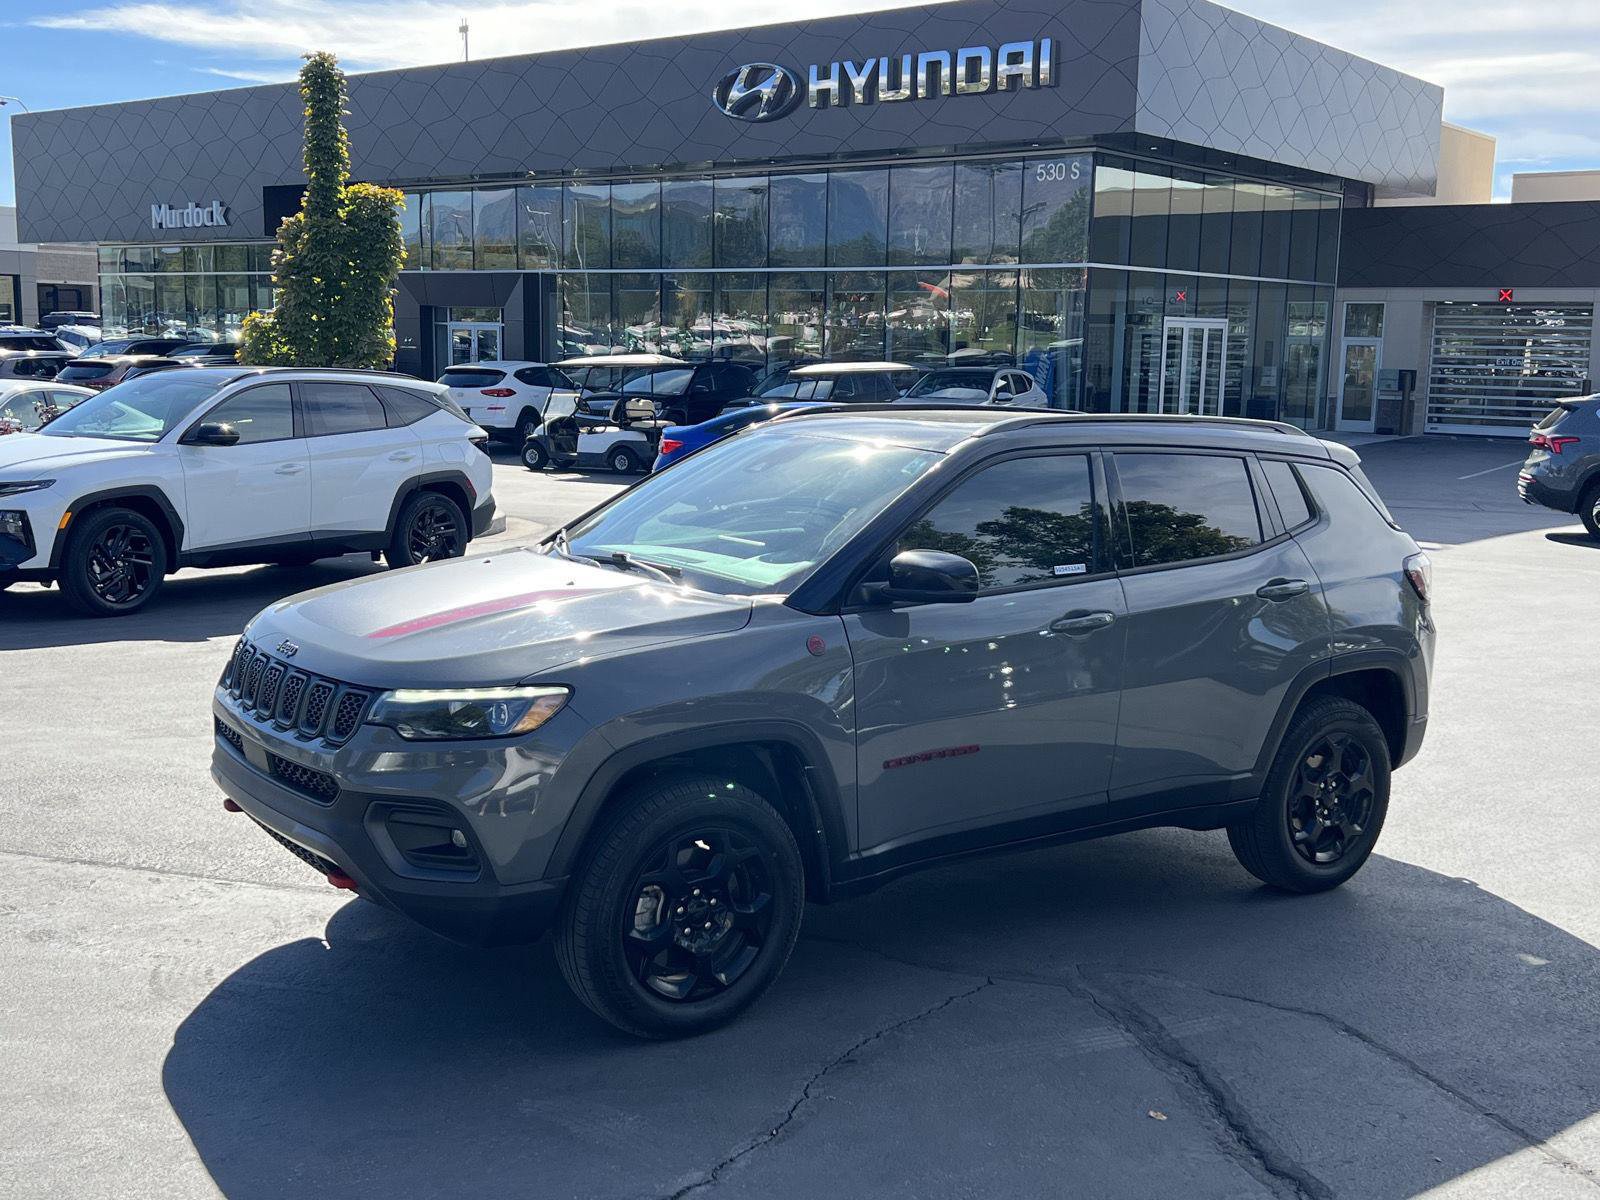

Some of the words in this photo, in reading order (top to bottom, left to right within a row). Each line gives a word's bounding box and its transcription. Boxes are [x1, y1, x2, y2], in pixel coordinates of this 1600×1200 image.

[809, 38, 1052, 108] HYUNDAI
[1036, 163, 1066, 181] 530
[1070, 162, 1080, 180] S
[151, 200, 228, 229] Murdock
[277, 639, 299, 658] Jeep
